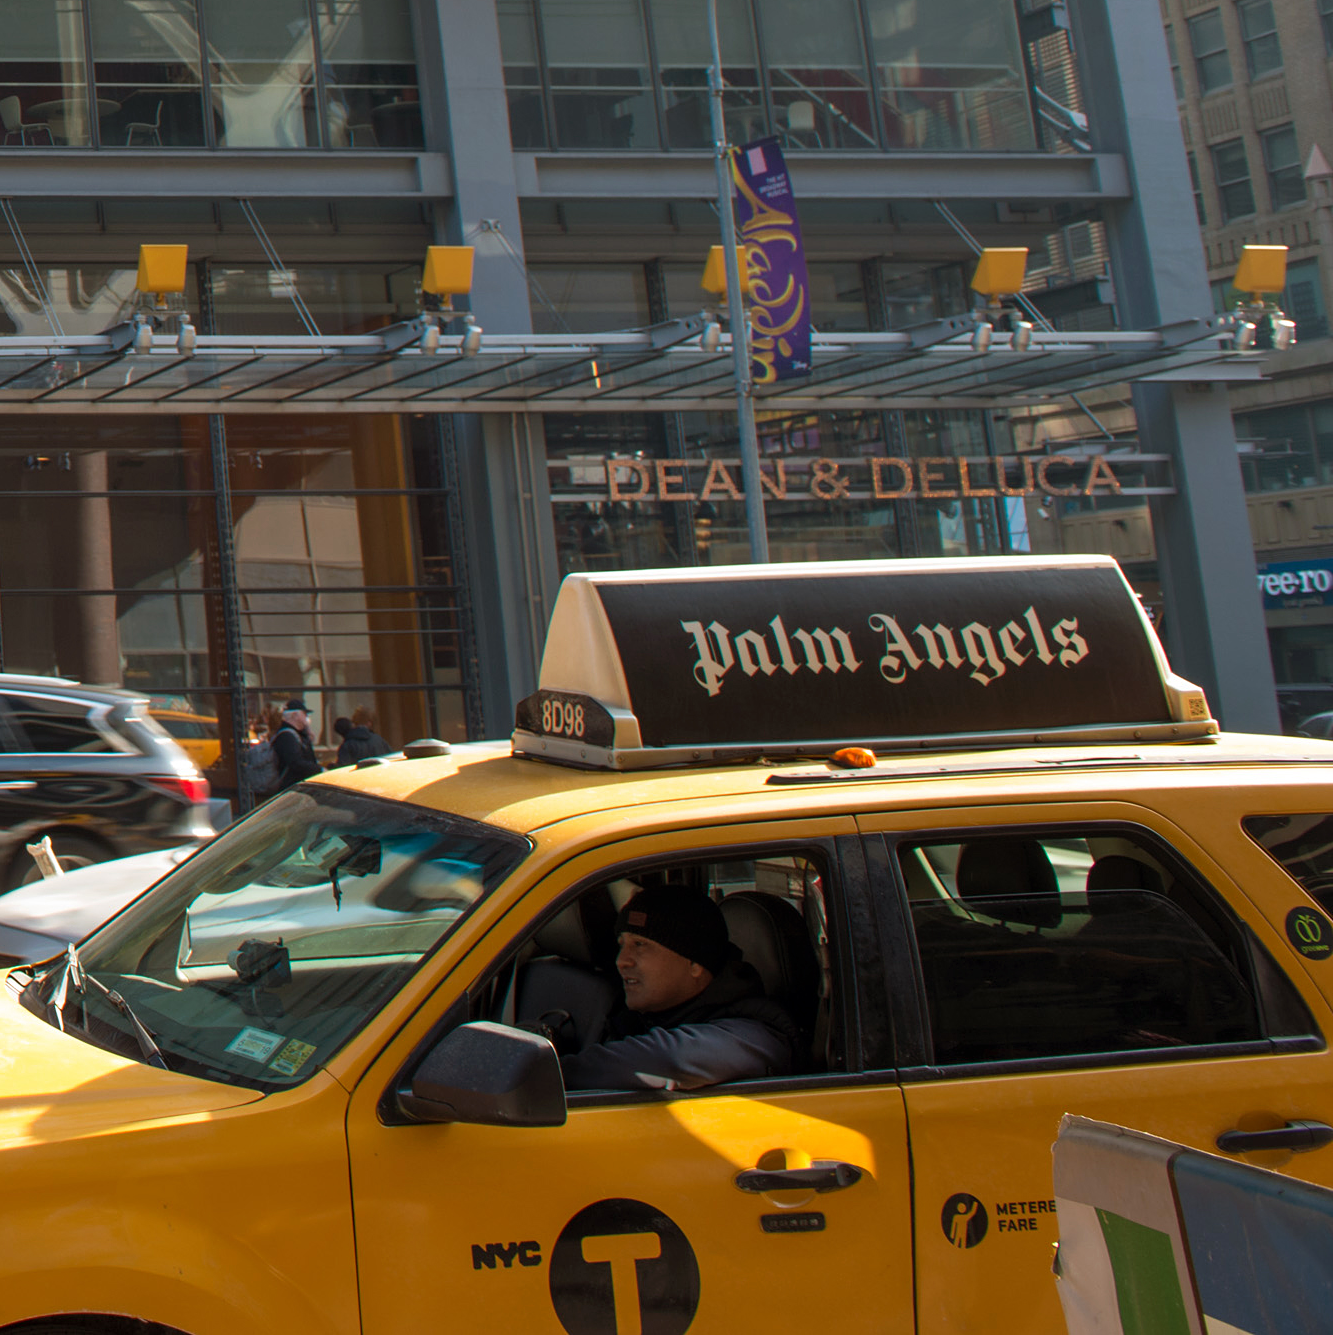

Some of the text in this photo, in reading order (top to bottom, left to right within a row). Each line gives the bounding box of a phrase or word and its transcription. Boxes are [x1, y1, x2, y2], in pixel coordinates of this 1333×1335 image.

[608, 454, 1121, 502] DEAN & DELUCA
[680, 605, 1090, 697] Palm Angels
[542, 699, 585, 737] 8D98
[996, 1200, 1057, 1216] METERE
[998, 1218, 1038, 1232] FARE
[471, 1240, 542, 1270] NYC
